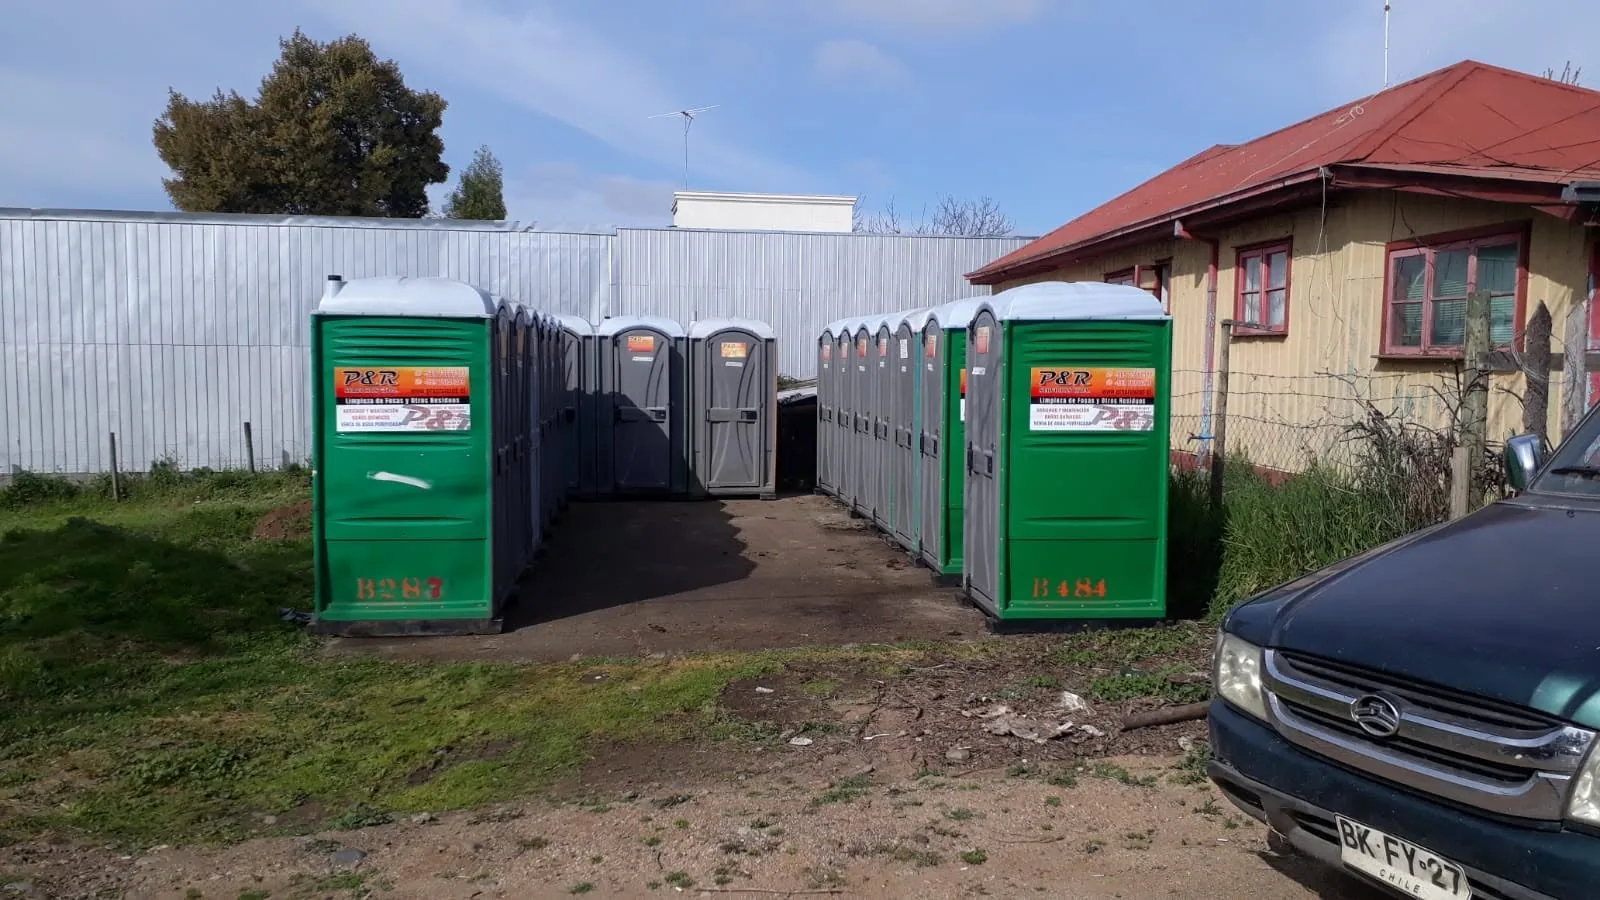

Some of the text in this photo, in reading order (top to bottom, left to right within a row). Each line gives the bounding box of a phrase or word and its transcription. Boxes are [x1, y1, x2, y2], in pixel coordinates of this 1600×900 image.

[343, 370, 399, 386] P&R
[1039, 370, 1092, 386] P&R
[1379, 868, 1421, 894] CHILE
